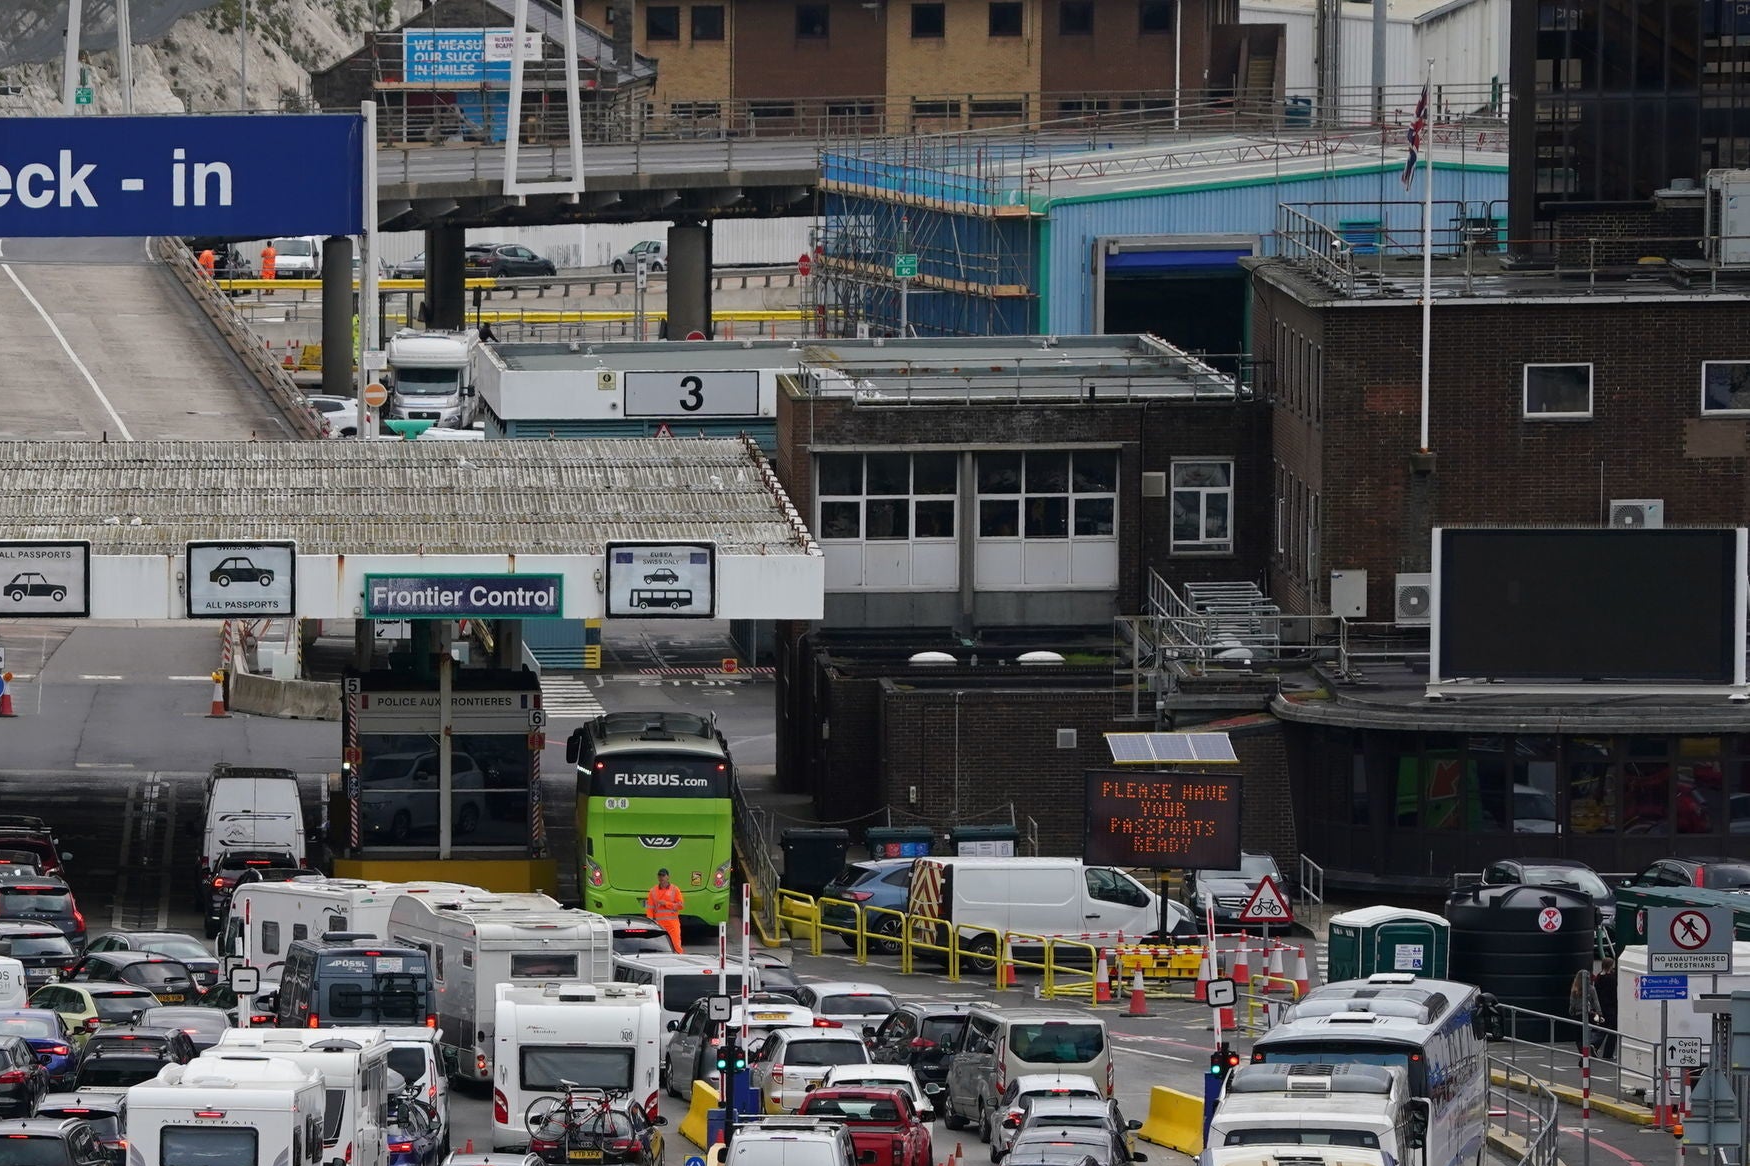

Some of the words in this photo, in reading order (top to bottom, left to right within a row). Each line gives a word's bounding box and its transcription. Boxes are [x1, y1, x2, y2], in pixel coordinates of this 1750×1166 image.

[414, 39, 440, 52] WE
[414, 51, 444, 65] OUR
[172, 148, 232, 207] in
[679, 375, 704, 412] 3
[18, 550, 72, 560] PASSPORTS
[373, 586, 464, 608] Frontier
[468, 586, 556, 608] Control
[205, 600, 222, 609] ALL
[224, 600, 279, 609] PASSPORTS
[347, 678, 359, 692] 5
[377, 697, 416, 707] POLICE
[451, 696, 512, 707] RONTIERES
[532, 711, 543, 724] 6
[1103, 781, 1171, 799] PLEASE
[1182, 784, 1228, 801] HAVE
[1140, 801, 1186, 818] YOUR
[1110, 818, 1216, 837] PASSPORTS
[645, 837, 673, 846] VDL
[1133, 836, 1192, 853] READY
[1664, 962, 1716, 970] PEDESTRIANS
[1678, 1039, 1698, 1049] Cycle
